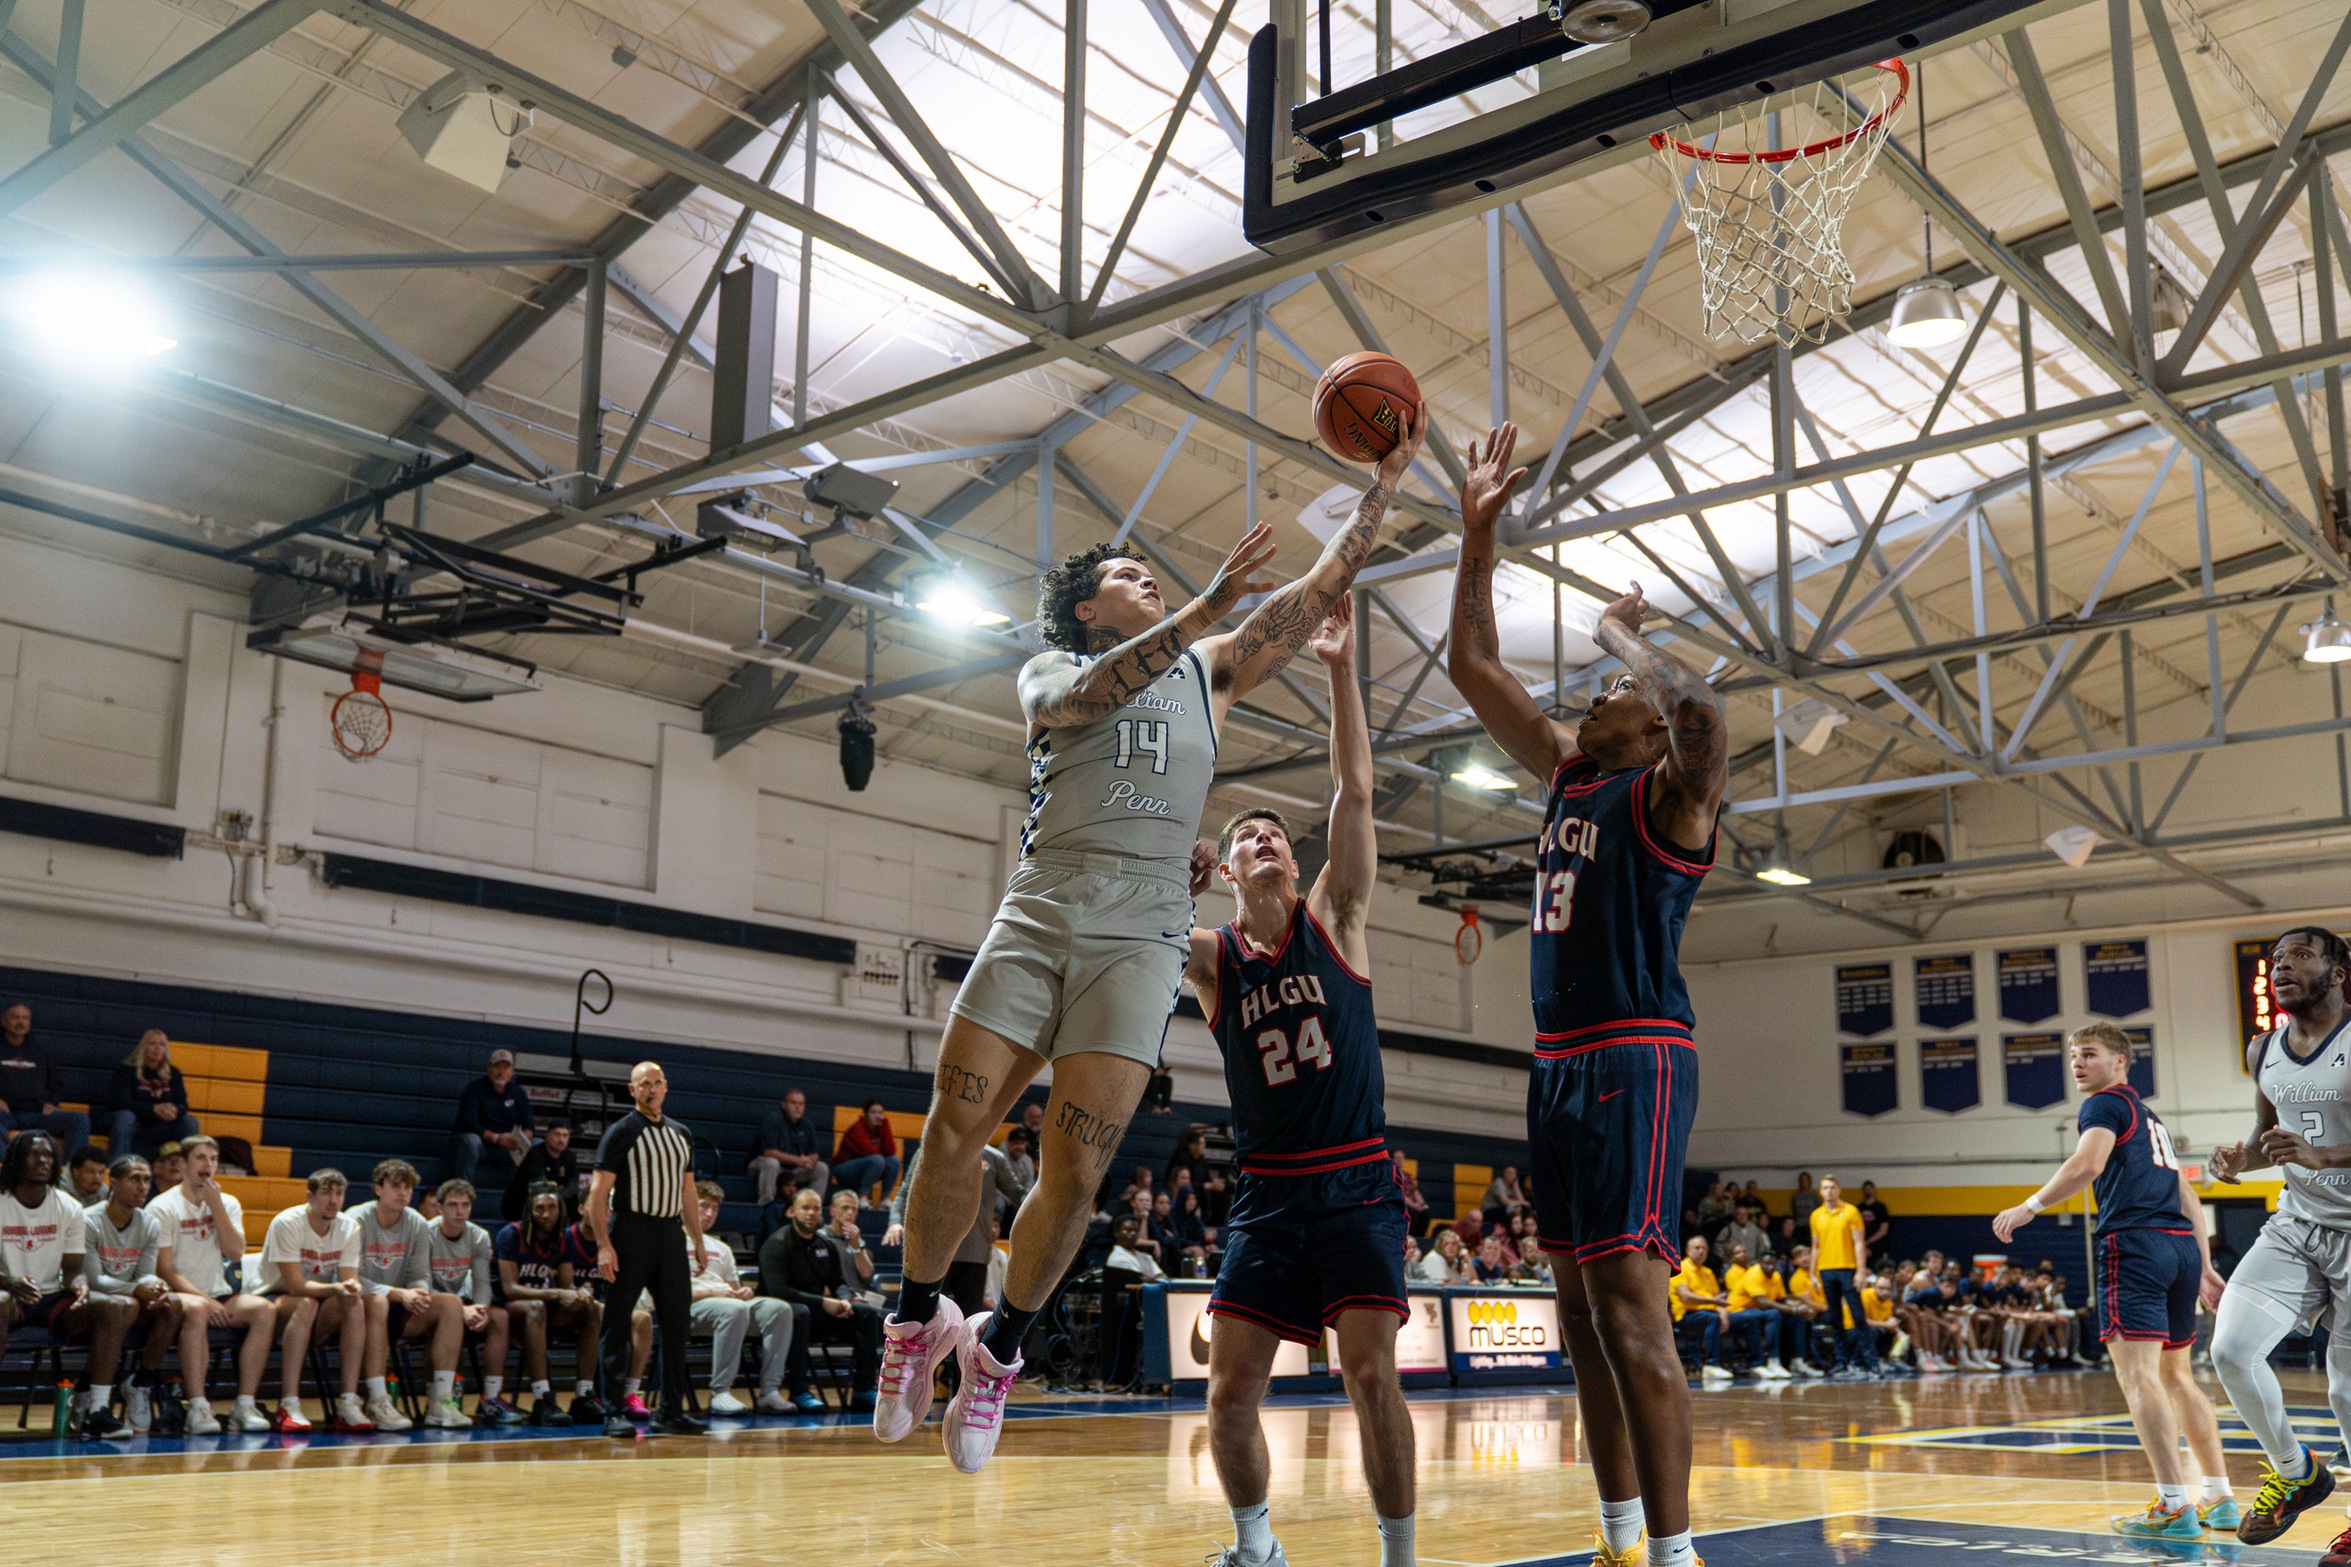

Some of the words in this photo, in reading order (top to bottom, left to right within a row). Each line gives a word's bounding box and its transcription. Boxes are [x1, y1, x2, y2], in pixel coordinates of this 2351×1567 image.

[1126, 688, 1187, 715] liam
[1114, 719, 1168, 775] 14
[1101, 779, 1170, 815] Penn
[1533, 869, 1577, 933] 13
[1241, 974, 1328, 1031] HLGU
[2253, 976, 2268, 995] 2
[2256, 995, 2269, 1015] 3
[1256, 1014, 1333, 1087] 24
[938, 1062, 989, 1104] IFES
[2272, 1080, 2342, 1105] William
[2146, 1117, 2179, 1172] 10
[2301, 1110, 2325, 1146] 2
[2305, 1169, 2350, 1187] Penn
